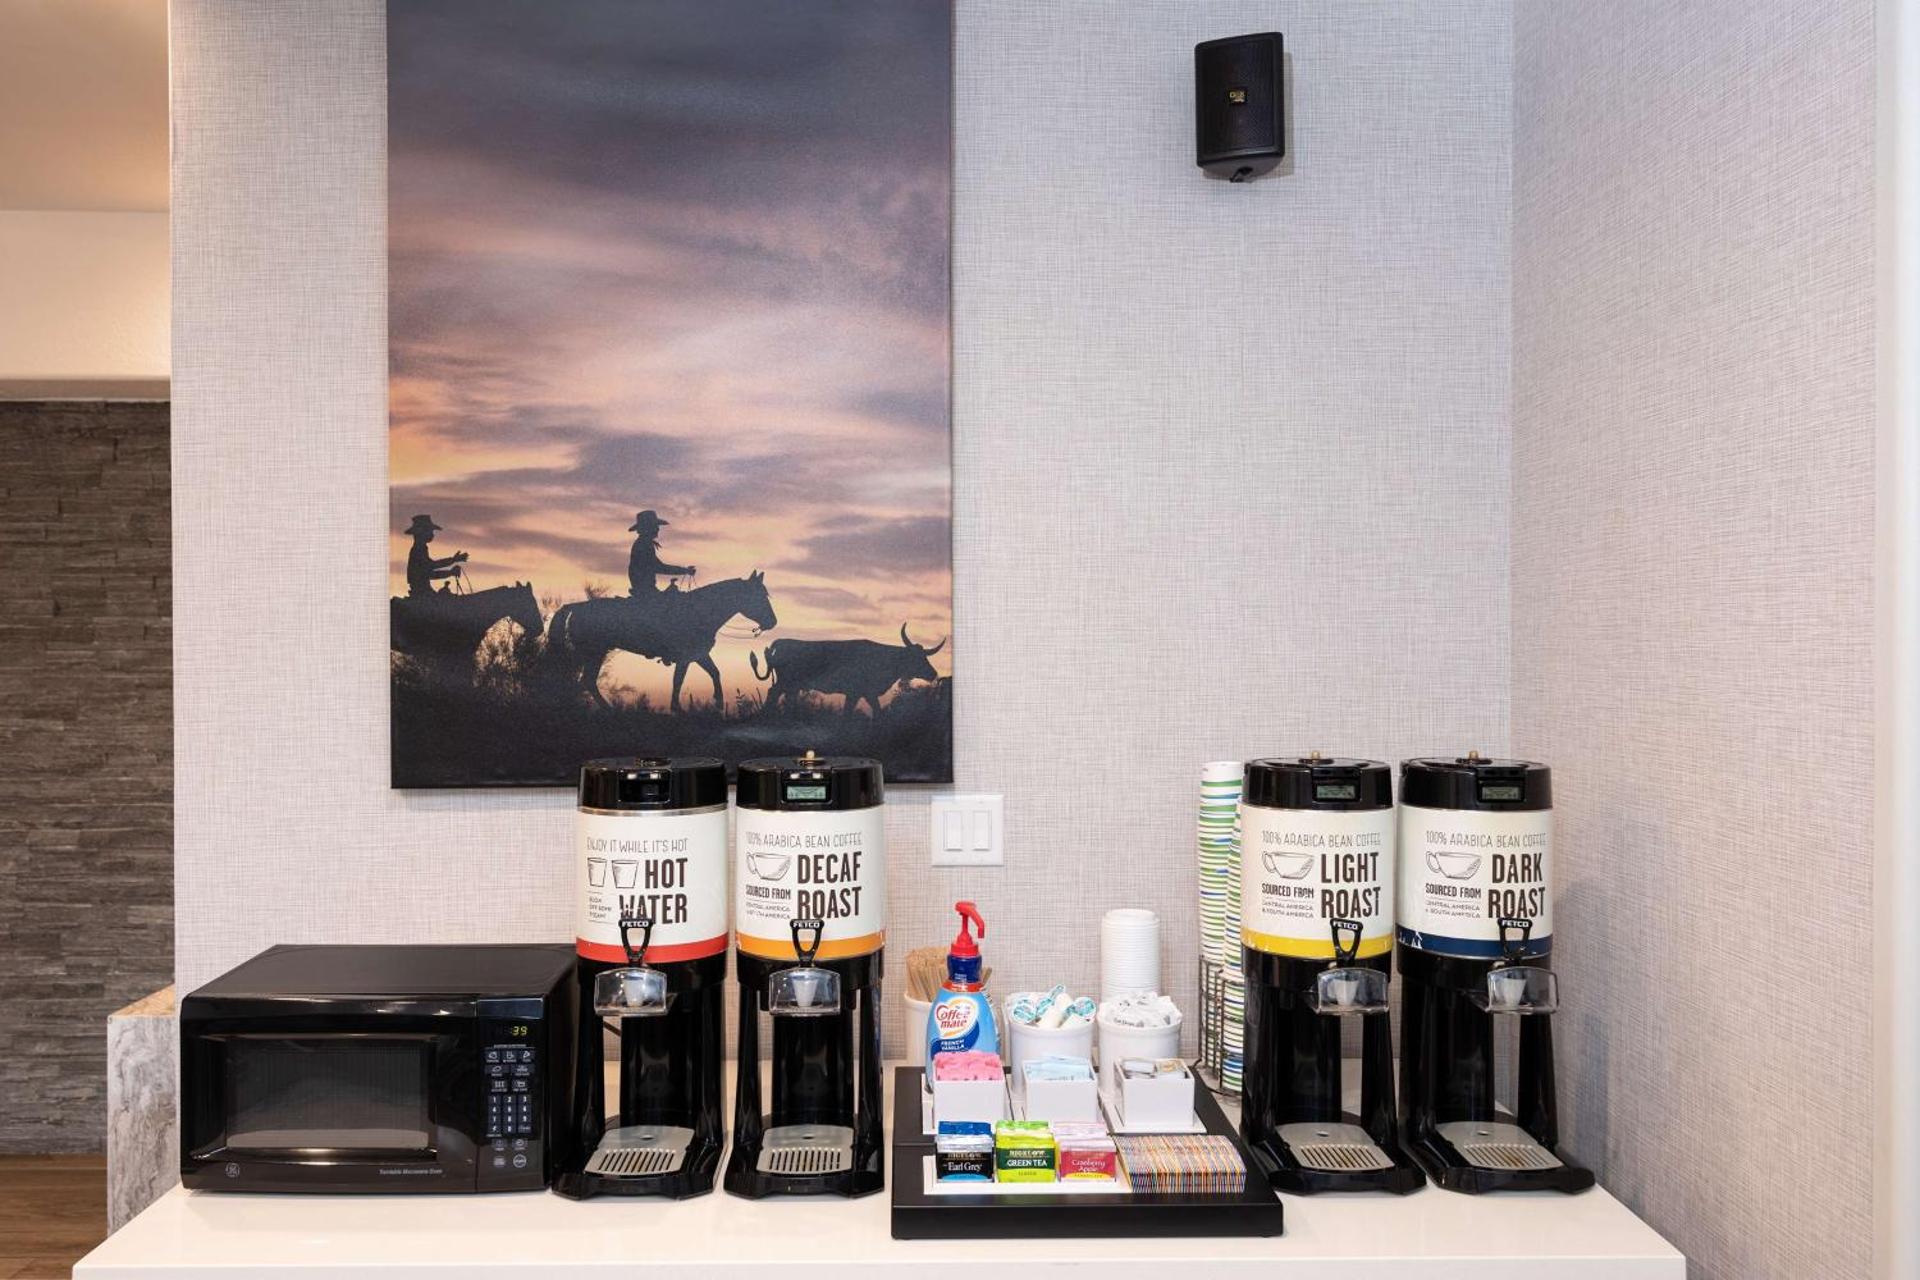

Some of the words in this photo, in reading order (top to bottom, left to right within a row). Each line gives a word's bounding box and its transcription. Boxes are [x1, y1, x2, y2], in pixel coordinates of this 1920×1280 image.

[610, 839, 617, 853] IT
[619, 839, 649, 854] WHILE
[652, 838, 669, 853] IT'S
[671, 837, 688, 853] HOT
[763, 833, 801, 849] ARABICA
[805, 834, 830, 848] BEAN
[833, 831, 862, 847] COFFEE
[1262, 830, 1282, 844] 100%
[1284, 832, 1325, 847] ARABICA
[1329, 834, 1353, 848] BEAN
[1356, 832, 1381, 847] COFFEE
[1426, 830, 1447, 845] 100%
[1450, 832, 1493, 848] ARABICA
[1496, 834, 1520, 848] BEAN
[1523, 832, 1546, 847] COFFEE
[645, 857, 688, 889] HOT
[797, 851, 862, 884] DECAF
[1321, 852, 1379, 884] LIGHT
[1492, 852, 1542, 884] DARK
[746, 884, 770, 899] SOURCED
[772, 887, 791, 900] FROM
[1262, 882, 1291, 897] SOURCED
[1293, 886, 1314, 899] FROM
[1426, 882, 1457, 897] SOURCED
[1460, 886, 1482, 899] FROM
[619, 893, 688, 925] WATER
[797, 886, 862, 920] ROAST
[1321, 886, 1381, 919] ROAST
[1488, 886, 1545, 919] ROAST
[621, 920, 649, 928] FETCO
[793, 921, 820, 929] FETCO
[1333, 920, 1358, 930] FETCO
[1501, 920, 1529, 928] FETCO
[512, 1026, 528, 1036] 39
[948, 1161, 963, 1171] Earl
[963, 1161, 982, 1172] Grey
[1007, 1159, 1032, 1167] GREEN
[1033, 1159, 1047, 1167] TEA
